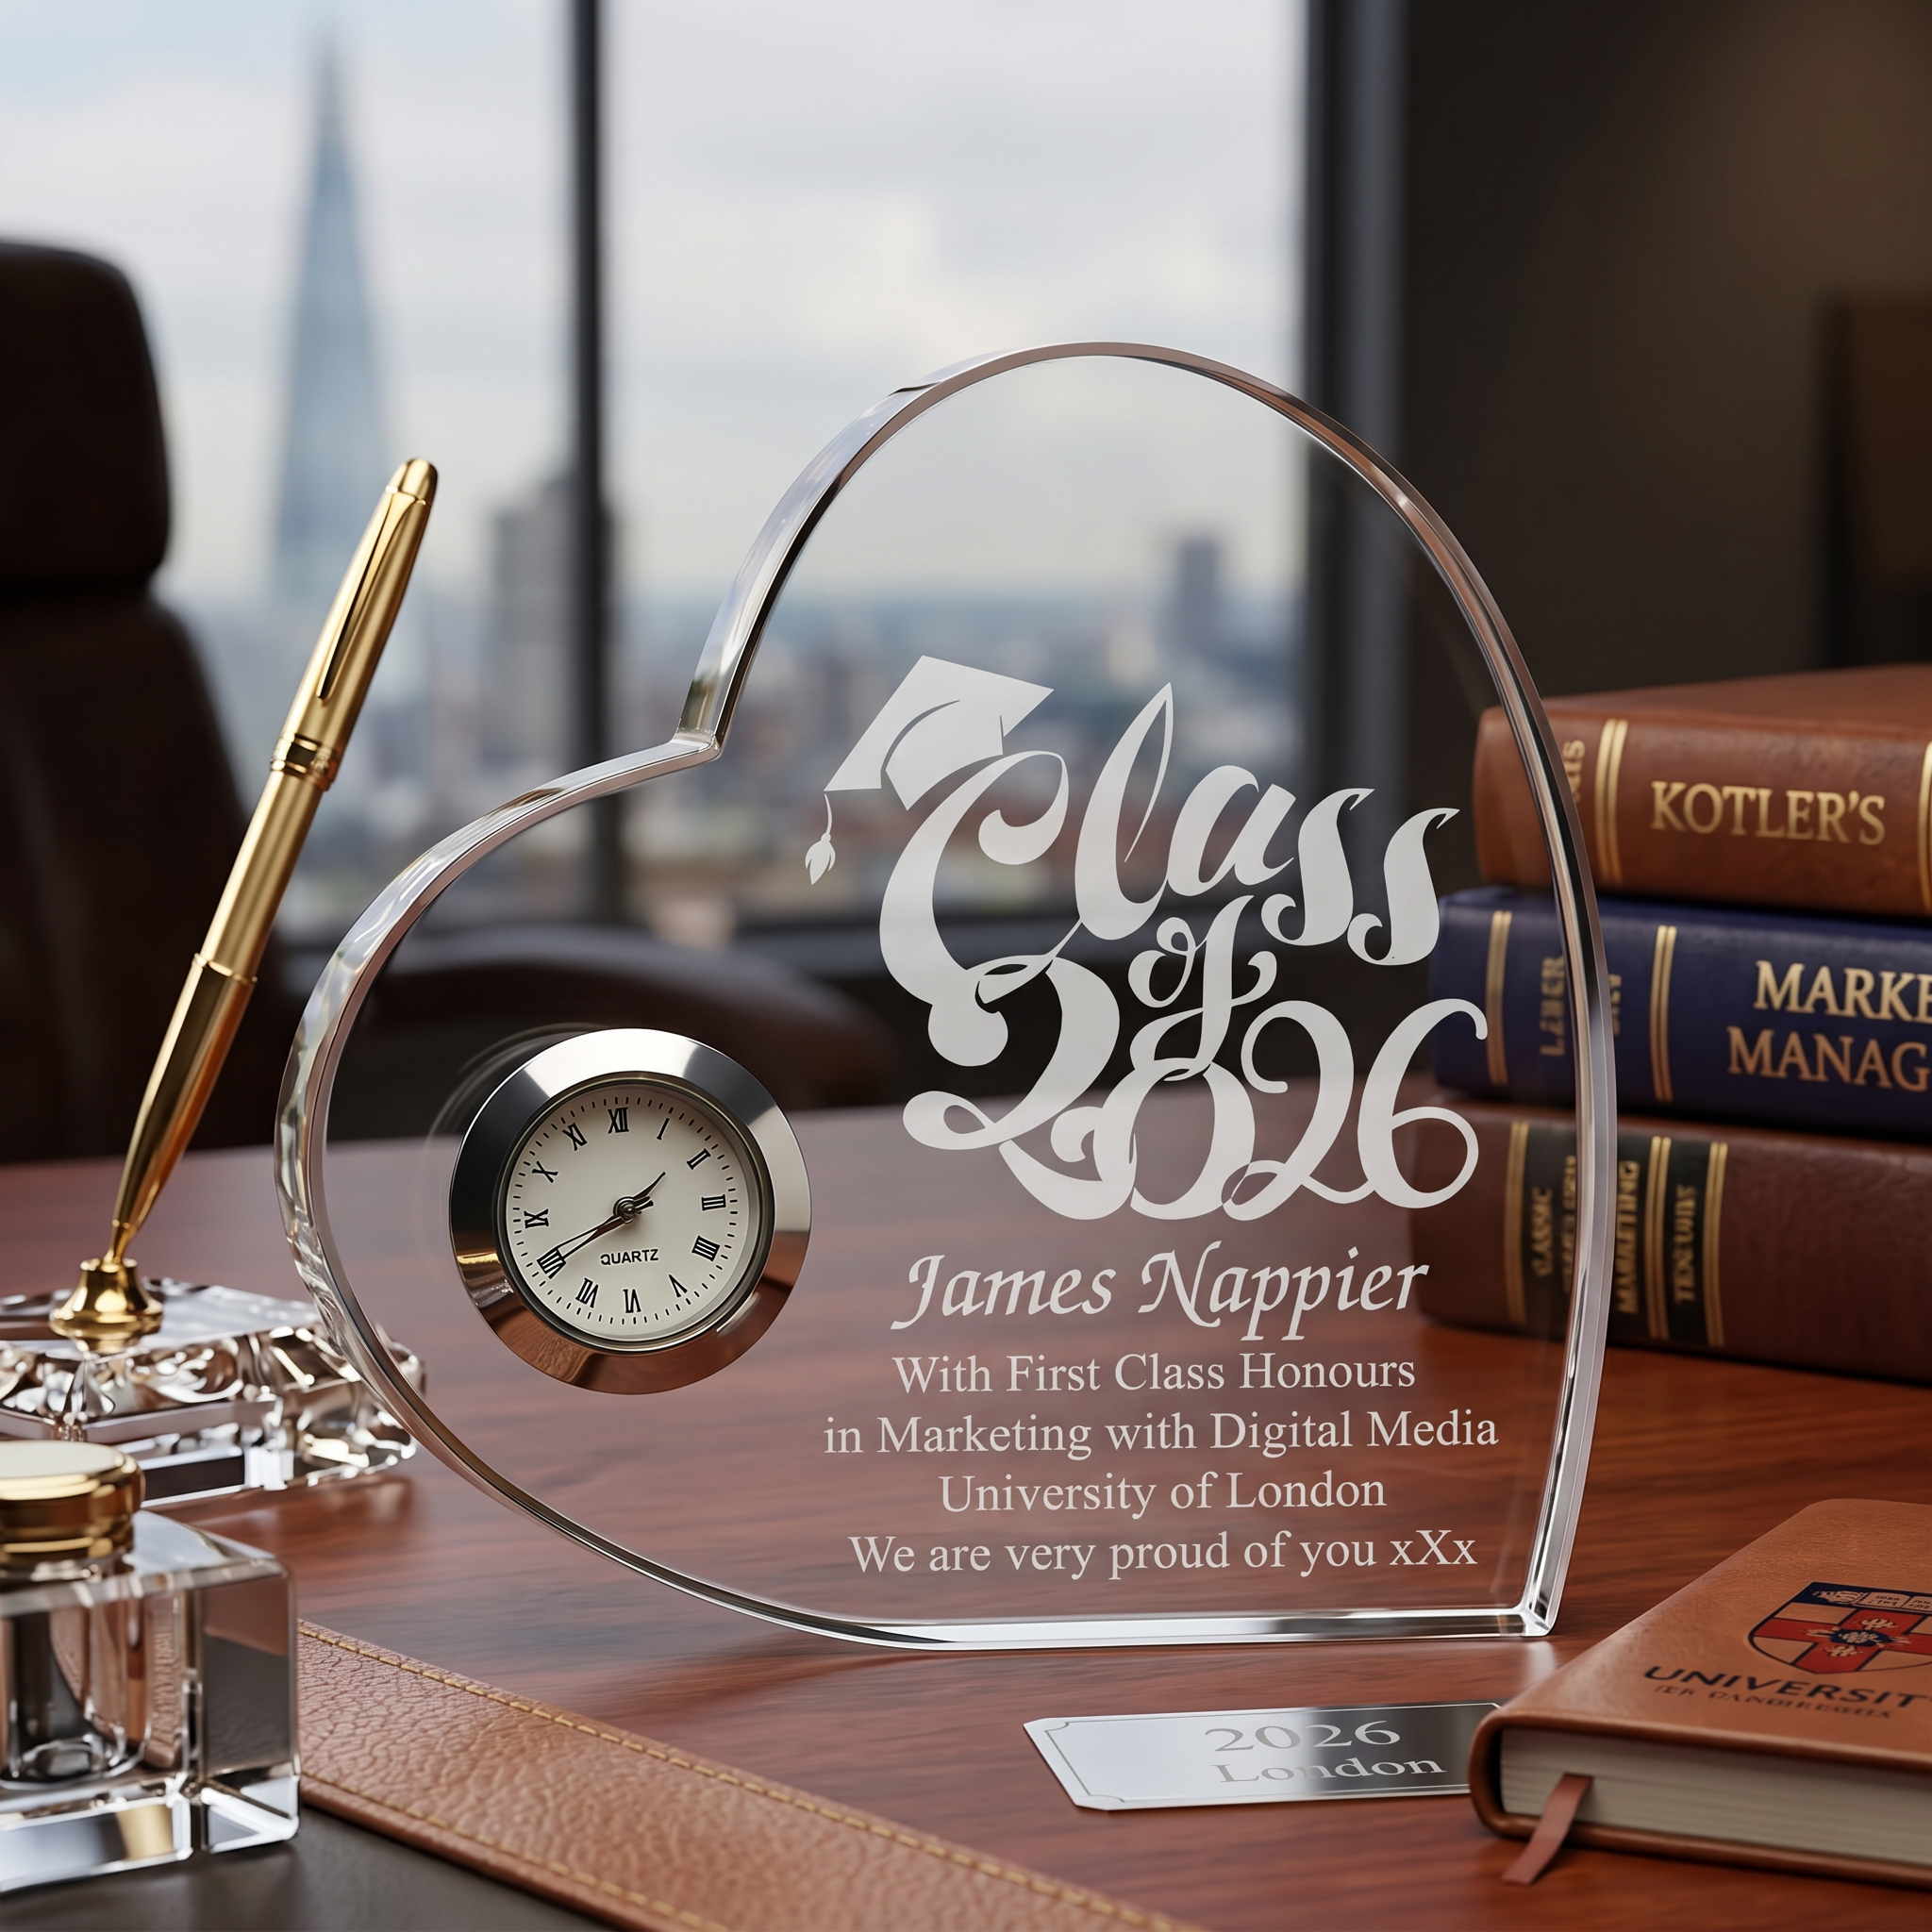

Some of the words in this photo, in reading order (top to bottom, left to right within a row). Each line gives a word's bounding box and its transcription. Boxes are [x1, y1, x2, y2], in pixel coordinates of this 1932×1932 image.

[1651, 781, 1886, 845] KOTLER'S
[880, 682, 1460, 1006] Class
[1128, 895, 1277, 1081] of
[1726, 1025, 1931, 1091] MANAG
[902, 956, 1488, 1221] 2026
[562, 1123, 588, 1152] XI
[608, 1107, 629, 1134] XII
[531, 1160, 558, 1183] X
[686, 1148, 710, 1170] II
[701, 1194, 726, 1211] III
[600, 1248, 659, 1266] QUARTZ
[891, 1255, 1117, 1331] James
[1138, 1241, 1430, 1341] Nappier
[892, 1355, 993, 1394] With
[1007, 1354, 1101, 1392] First
[1115, 1353, 1224, 1391] Class
[1240, 1352, 1415, 1390] Honours
[824, 1416, 863, 1454] in
[877, 1413, 1091, 1461] Marketing
[1106, 1412, 1197, 1451] with
[1210, 1410, 1352, 1459] Digital
[1368, 1408, 1499, 1447] Media
[939, 1472, 1157, 1520] University
[1171, 1472, 1217, 1510] of
[1226, 1471, 1387, 1509] London
[848, 1536, 915, 1573] We
[929, 1544, 991, 1573] are
[1005, 1544, 1096, 1580] very
[1108, 1531, 1230, 1581] proud
[1244, 1530, 1291, 1569] of
[1300, 1538, 1377, 1578] you
[1390, 1529, 1477, 1566] xXx
[1644, 1666, 1932, 1707] UNIVERSIT
[1205, 1720, 1400, 1752] 2026
[1208, 1757, 1447, 1783] London
